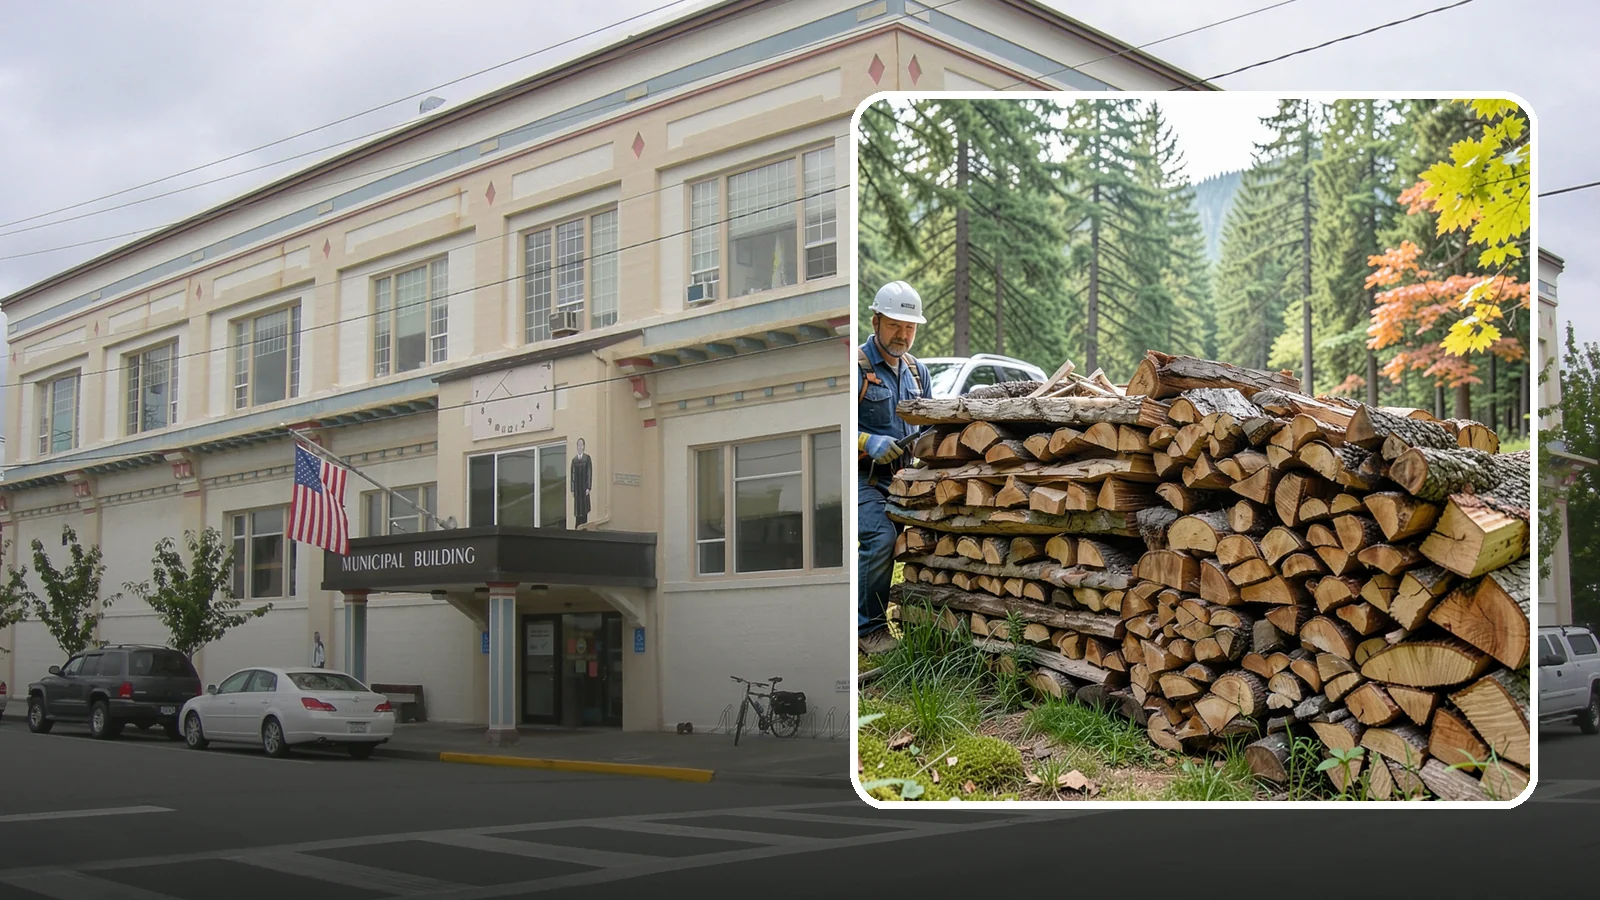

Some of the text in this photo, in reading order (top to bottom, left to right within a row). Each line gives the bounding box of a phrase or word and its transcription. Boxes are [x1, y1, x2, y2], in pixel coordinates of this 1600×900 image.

[476, 390, 479, 398] 7
[481, 407, 484, 415] 8
[488, 418, 492, 426] 9
[529, 414, 533, 422] 3
[495, 424, 500, 432] 10
[341, 546, 475, 572] MUNICIPAL BUILDING
